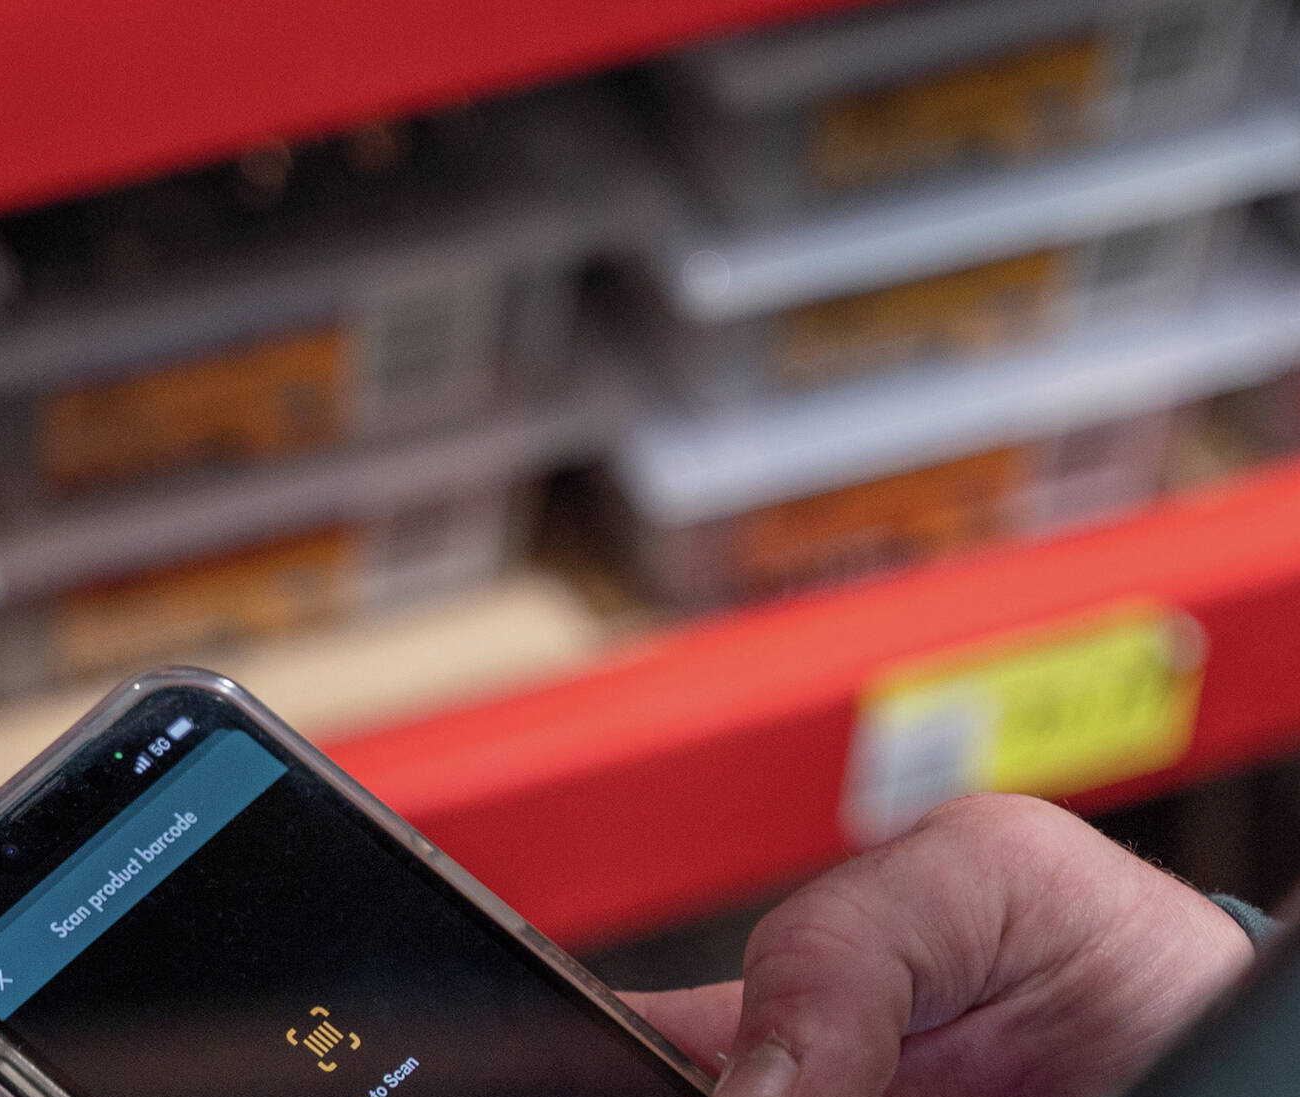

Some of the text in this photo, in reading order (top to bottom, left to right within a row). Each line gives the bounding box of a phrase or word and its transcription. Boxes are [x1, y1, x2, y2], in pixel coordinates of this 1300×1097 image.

[148, 736, 172, 758] 5G
[50, 810, 198, 939] Scan product barcode
[383, 1056, 420, 1089] Scan
